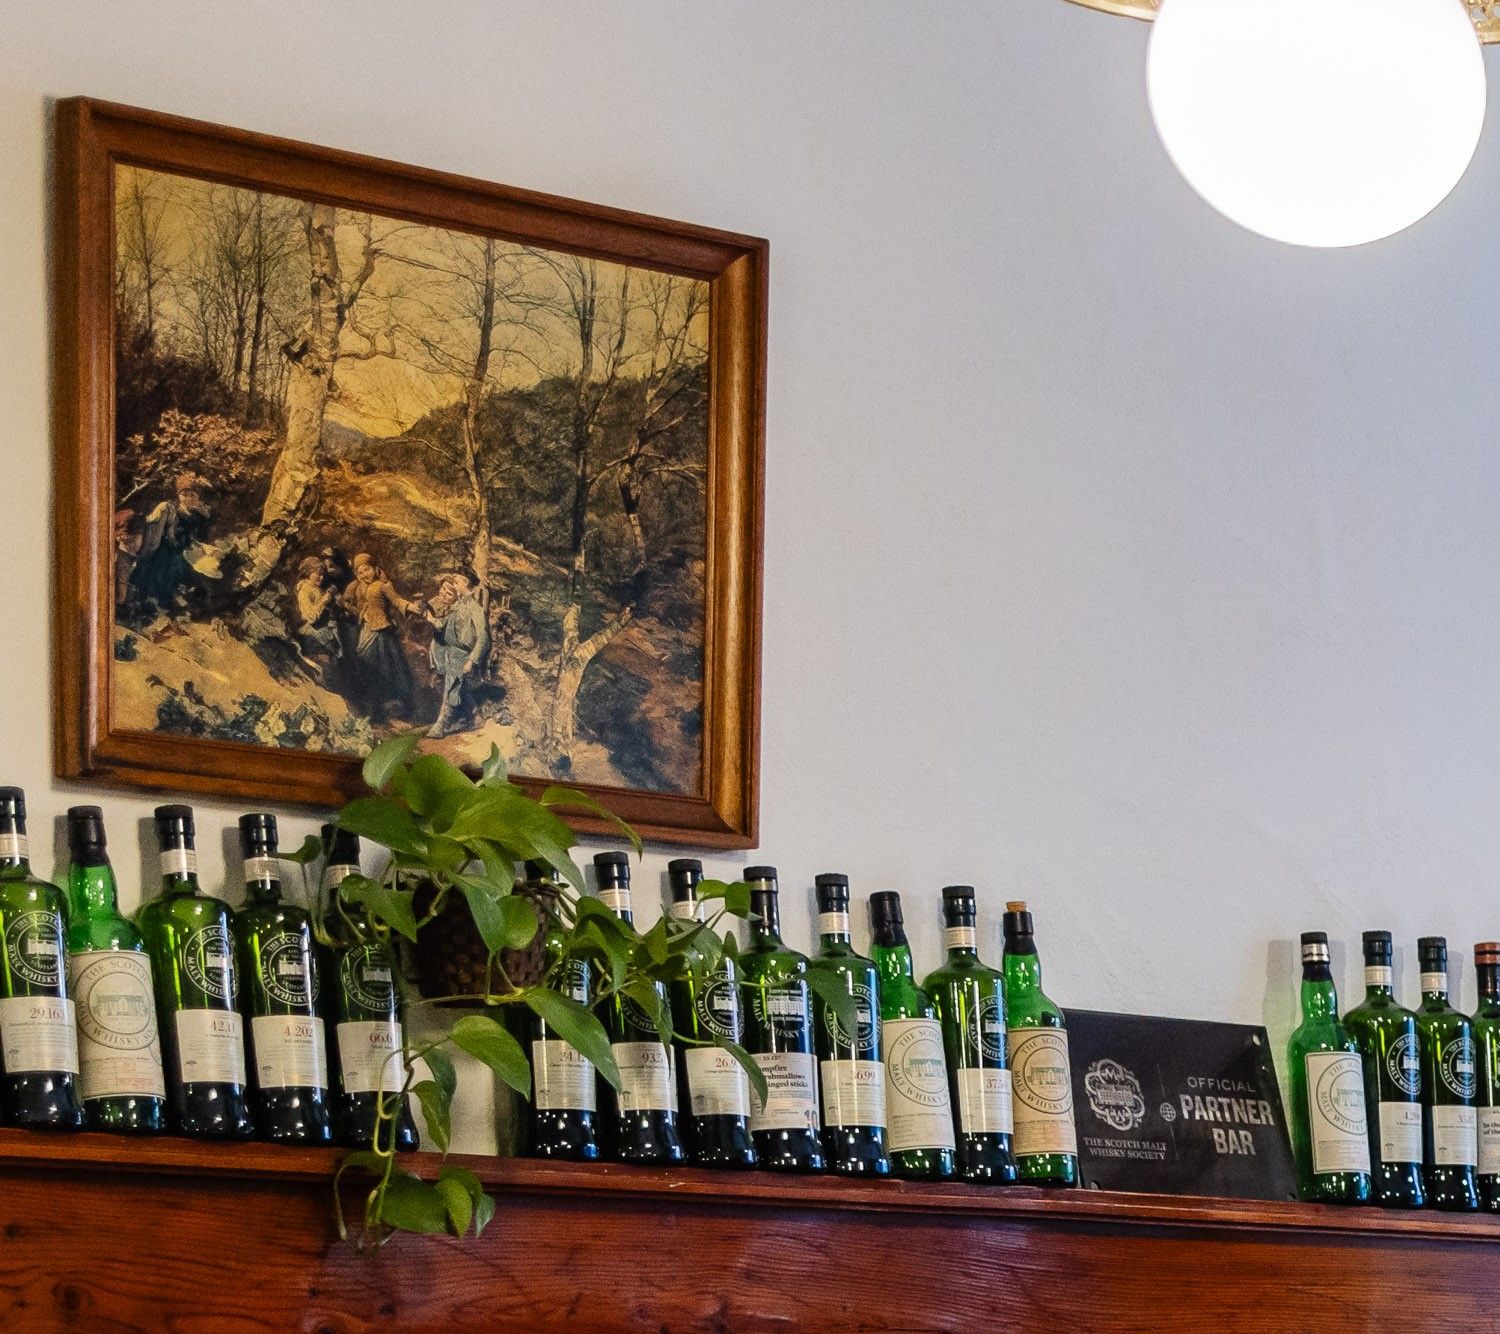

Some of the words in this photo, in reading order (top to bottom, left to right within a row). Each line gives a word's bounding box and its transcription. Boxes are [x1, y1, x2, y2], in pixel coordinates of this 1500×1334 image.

[22, 966, 58, 984] WHISKY
[86, 964, 104, 982] THE
[186, 956, 203, 982] MALT
[93, 1025, 141, 1046] WHISKY
[899, 1032, 915, 1047] THE
[1022, 1040, 1039, 1054] THE
[891, 1063, 905, 1087] MALT
[906, 1086, 943, 1104] WHISKY
[1187, 1076, 1256, 1093] OFFICIAL
[1026, 1093, 1064, 1111] WHISKY
[1179, 1094, 1275, 1126] PARTNER
[1082, 1137, 1103, 1147] THE
[1105, 1139, 1140, 1150] SCOTCH
[1142, 1141, 1167, 1151] MALT
[1212, 1127, 1256, 1156] BAR
[1089, 1148, 1126, 1158] WHISKY
[1127, 1149, 1167, 1161] SOCIETY
